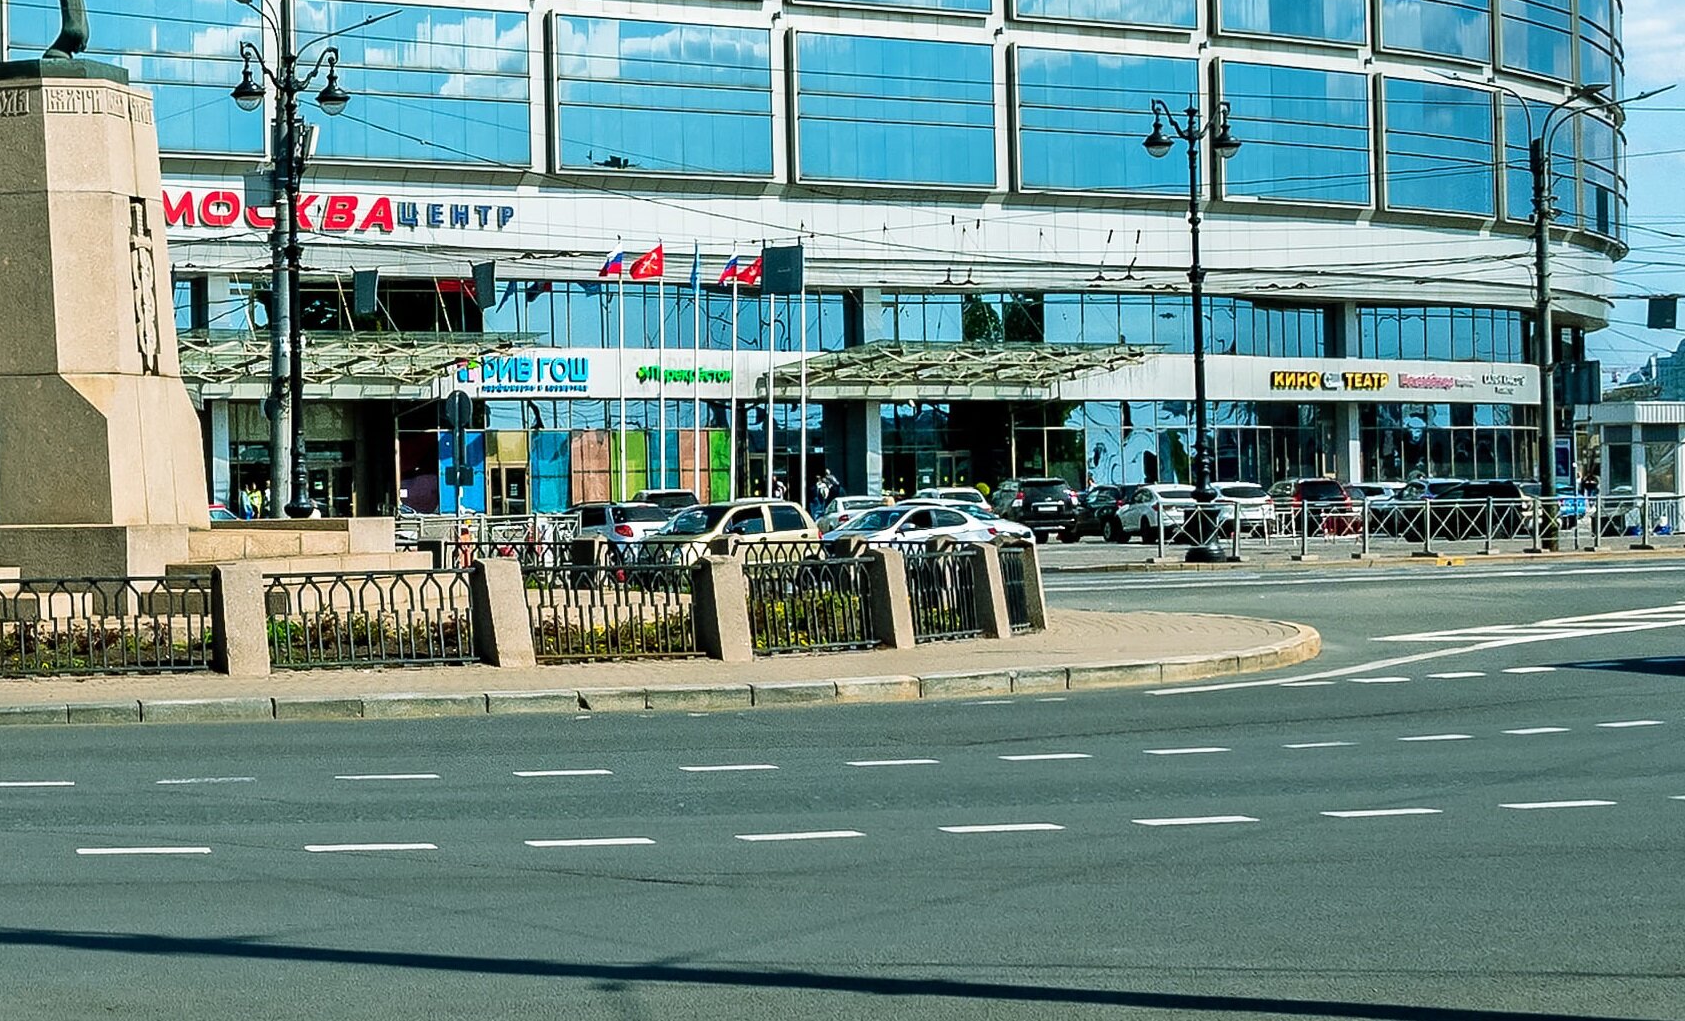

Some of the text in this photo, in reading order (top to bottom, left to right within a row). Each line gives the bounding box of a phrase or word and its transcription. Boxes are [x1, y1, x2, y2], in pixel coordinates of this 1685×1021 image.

[397, 201, 514, 231] ЦЕНТР
[481, 356, 589, 383] РИВ ГОШ
[1271, 371, 1321, 391] КИНО
[1341, 371, 1390, 391] ТЕАТР
